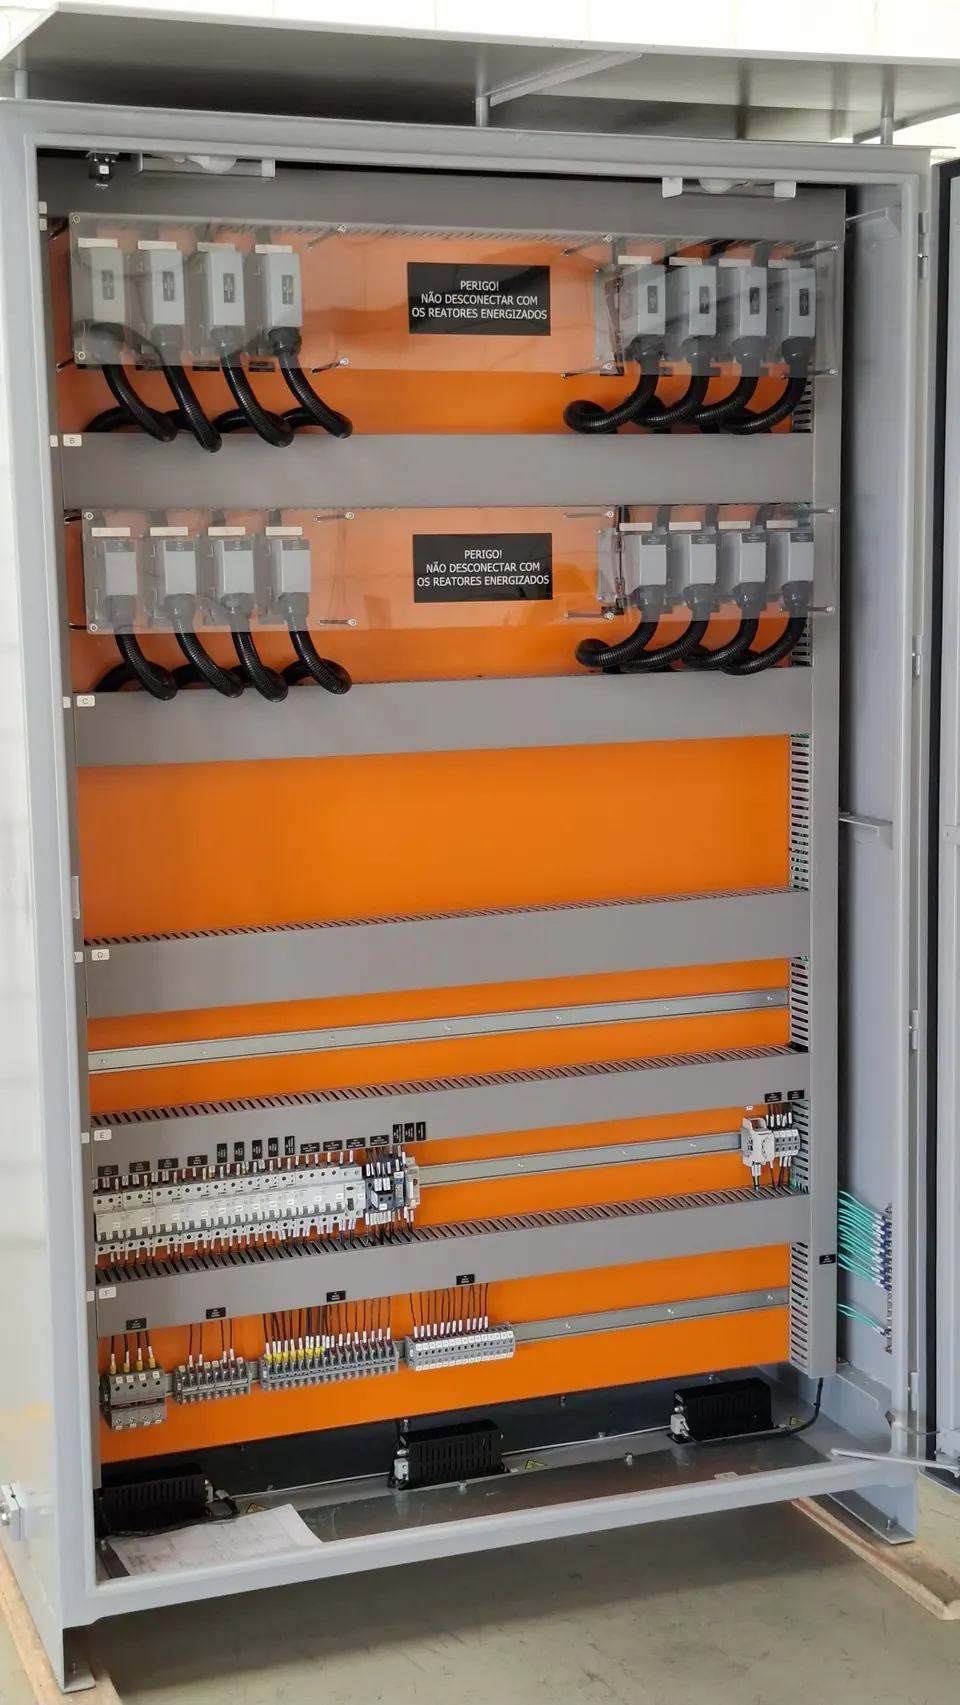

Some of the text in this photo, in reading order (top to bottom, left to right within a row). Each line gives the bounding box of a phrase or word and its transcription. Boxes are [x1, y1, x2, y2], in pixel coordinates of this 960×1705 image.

[460, 280, 500, 291] PERIGO!
[421, 291, 538, 306] NÃO DESCONECTAR COM
[411, 307, 548, 320] OS REATORES ENERGIZADOS
[464, 549, 503, 560] PERIGO!
[426, 561, 540, 574] NÃO DESCONECTAR COM
[416, 574, 550, 587] OS REATORES ENERGIZADOS
